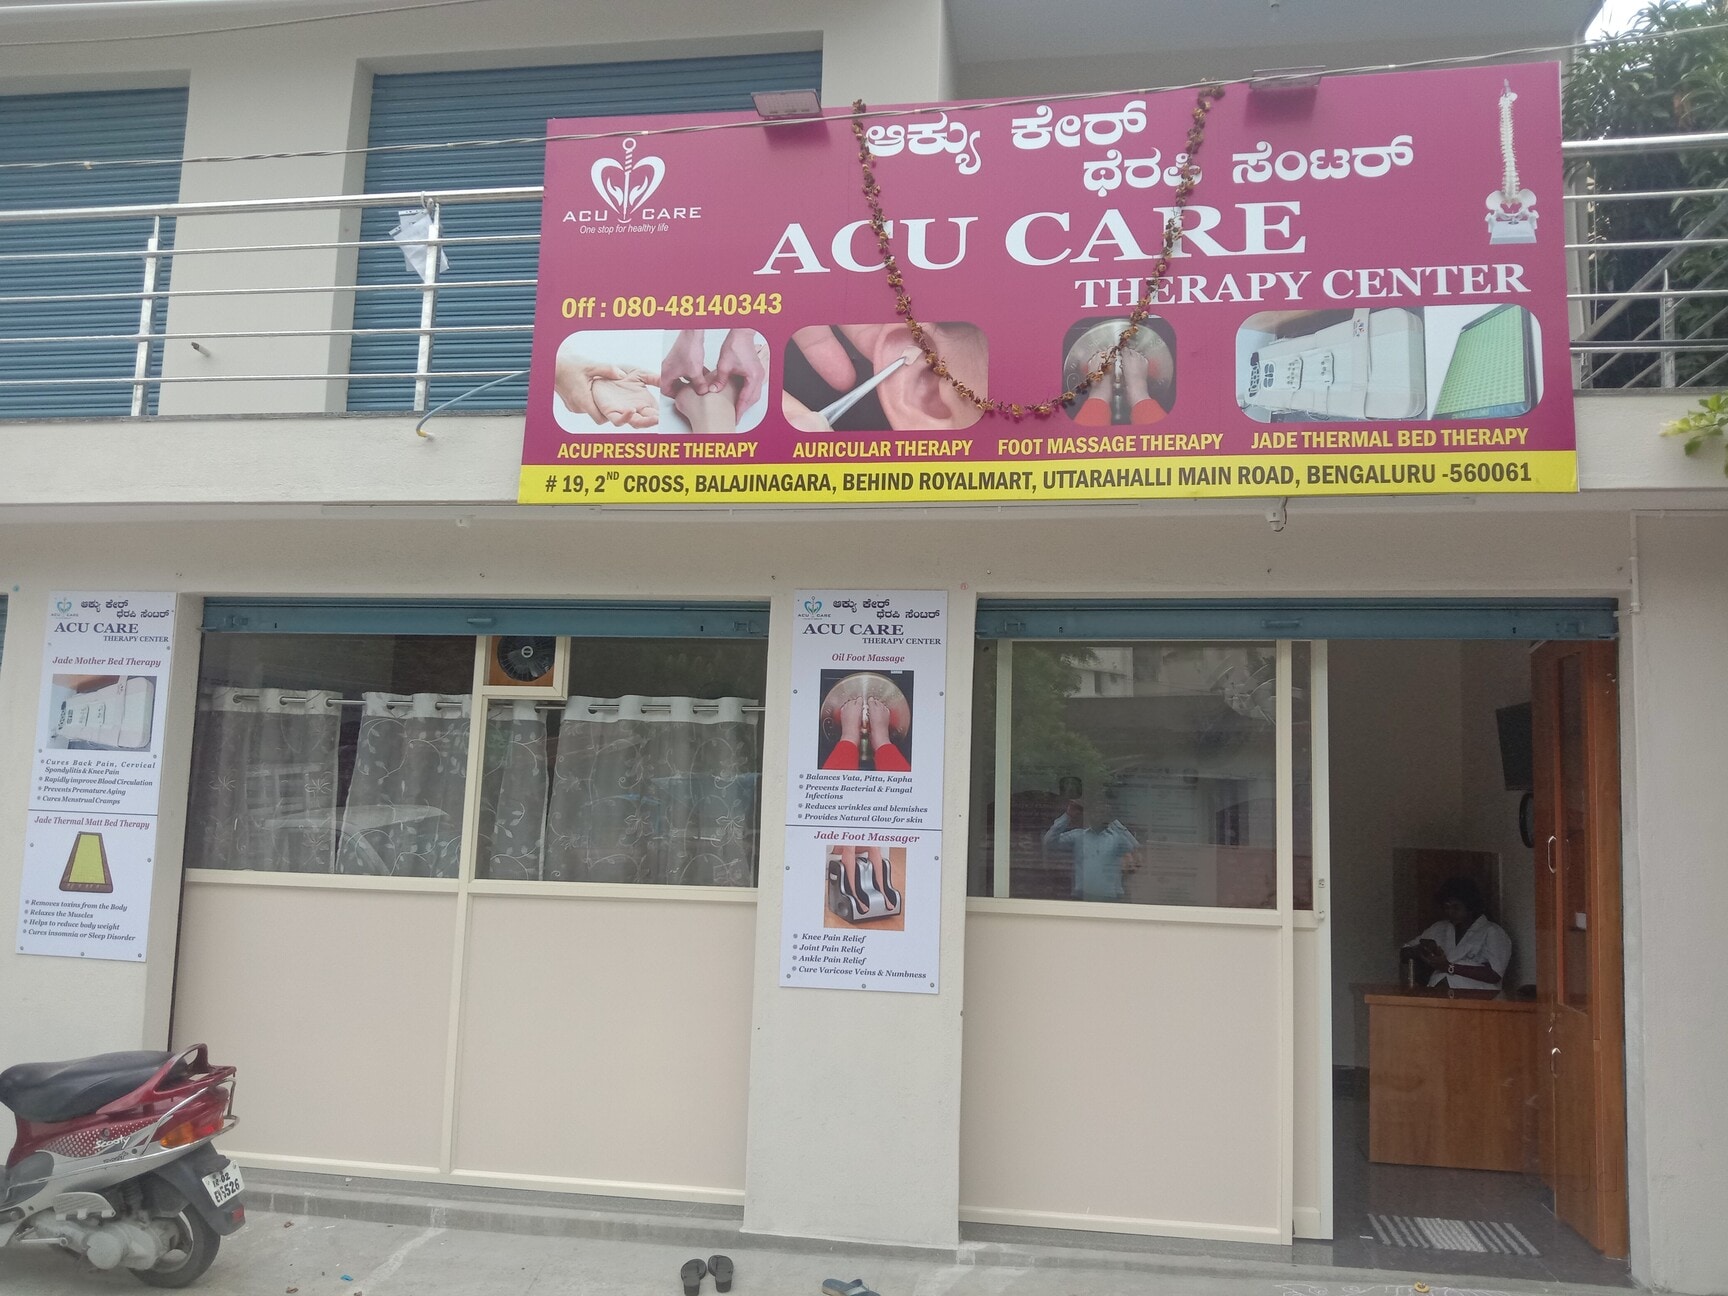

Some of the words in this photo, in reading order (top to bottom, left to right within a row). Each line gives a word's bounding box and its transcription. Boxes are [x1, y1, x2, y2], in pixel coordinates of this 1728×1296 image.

[1011, 100, 1147, 150] ಕೇರ್
[1232, 135, 1414, 184] ಸೆಂಟರ್
[563, 209, 608, 222] ACU
[642, 207, 702, 220] CARE
[579, 225, 596, 234] One
[598, 225, 614, 235] stop
[615, 224, 627, 233] for
[627, 223, 656, 233] healthy
[657, 223, 669, 232] life
[753, 216, 979, 275] ACU
[1005, 201, 1306, 266] CARE
[1075, 271, 1312, 308] THERAPY
[1322, 263, 1531, 298] CENTER
[561, 297, 596, 319] Off
[612, 293, 783, 318] 080-48140343
[998, 438, 1043, 456] FOOT
[1048, 436, 1136, 454] MASSAGE
[1140, 433, 1223, 451] THERAPY
[1250, 432, 1298, 450] JADE
[1301, 430, 1393, 448] THERMAL
[1398, 429, 1437, 447] BED
[1441, 428, 1529, 446] THERAPY
[557, 443, 680, 459] ACUPRESSURE
[683, 441, 758, 458] THERAPY
[793, 440, 892, 458] AURICULAR
[895, 440, 973, 457] THERAPY
[546, 477, 557, 492] #
[562, 475, 590, 496] 19,
[624, 475, 690, 496] CROSS,
[695, 472, 836, 495] BALAJINAGARA,
[843, 472, 914, 491] BEHIND
[919, 471, 1037, 493] ROYALMART,
[1043, 468, 1172, 489] UTTARAHALLI
[1178, 466, 1232, 486] MAIN
[1238, 466, 1301, 489] ROAD,
[1307, 464, 1436, 484] BENGALURU
[1442, 462, 1531, 483] -560061
[54, 622, 90, 633] ACU
[93, 622, 138, 634] CARE
[803, 624, 845, 635] ACU
[850, 624, 904, 635] CARE
[52, 656, 73, 665] Jade
[74, 657, 106, 665] Mother
[107, 657, 123, 666] Bed
[125, 658, 161, 668] Therapy
[831, 653, 845, 662] Oil
[846, 654, 866, 662] Foot
[867, 654, 905, 663] Massage
[96, 760, 118, 768] Pain,
[121, 761, 156, 769] Cervical
[45, 767, 82, 775] Spondylitis
[44, 776, 71, 784] Rapidly
[70, 777, 98, 785] improve
[842, 774, 862, 782] Vata,
[864, 775, 885, 783] Pitta,
[887, 775, 913, 785] Kapha
[805, 784, 839, 792] Prevents
[840, 785, 876, 793] Bacterial
[885, 786, 913, 794] Fungal
[805, 792, 843, 800] Infections
[838, 804, 872, 812] wrinkles
[889, 805, 928, 813] blemishes
[34, 816, 53, 824] Jade
[53, 816, 84, 825] Thermal
[84, 818, 103, 826] Matt
[103, 819, 118, 827] Bed
[119, 819, 150, 830] Therapy
[804, 813, 838, 821] Provides
[839, 814, 870, 822] Natural
[891, 816, 905, 824] for
[814, 831, 839, 840] Jade
[841, 832, 865, 841] Foot
[867, 833, 920, 844] Massager
[110, 904, 128, 912] Body
[30, 909, 55, 917] Relaxes
[67, 911, 94, 919] Muscles
[29, 919, 48, 927] Helps
[48, 930, 79, 938] insomnia
[88, 932, 106, 940] Sleep
[106, 933, 136, 941] Disorder
[802, 933, 821, 941] Knee
[822, 934, 841, 942] Pain
[842, 935, 867, 944] Relief
[799, 944, 819, 952] Joint
[821, 945, 839, 953] Pain
[840, 946, 865, 954] Relief
[799, 955, 821, 963] Ankle
[823, 956, 841, 964] Pain
[842, 957, 867, 965] Relief
[819, 967, 852, 975] Varicose
[855, 968, 876, 976] Veins
[885, 970, 927, 979] Numbness
